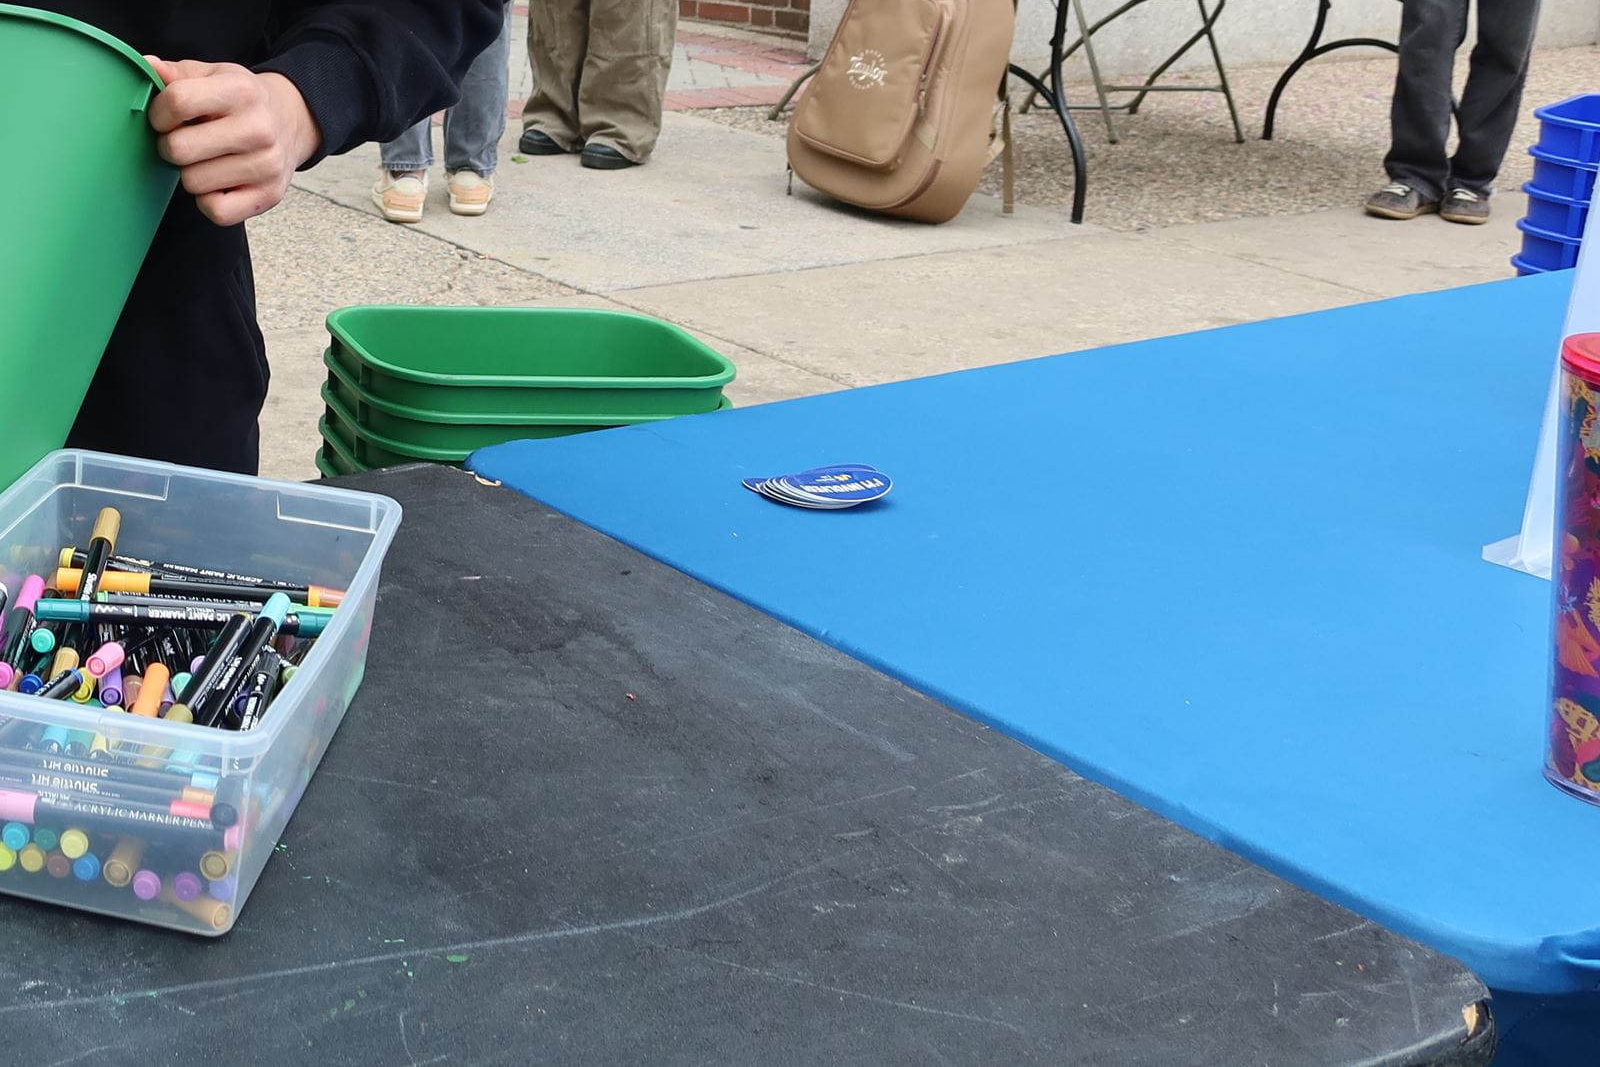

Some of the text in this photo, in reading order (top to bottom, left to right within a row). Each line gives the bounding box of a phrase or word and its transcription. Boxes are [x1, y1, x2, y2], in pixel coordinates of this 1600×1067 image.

[148, 607, 186, 621] MARKER
[187, 608, 215, 622] PAINT
[74, 802, 128, 818] ACRYLIC
[128, 809, 182, 826] MARKER
[181, 816, 207, 830] PEN
